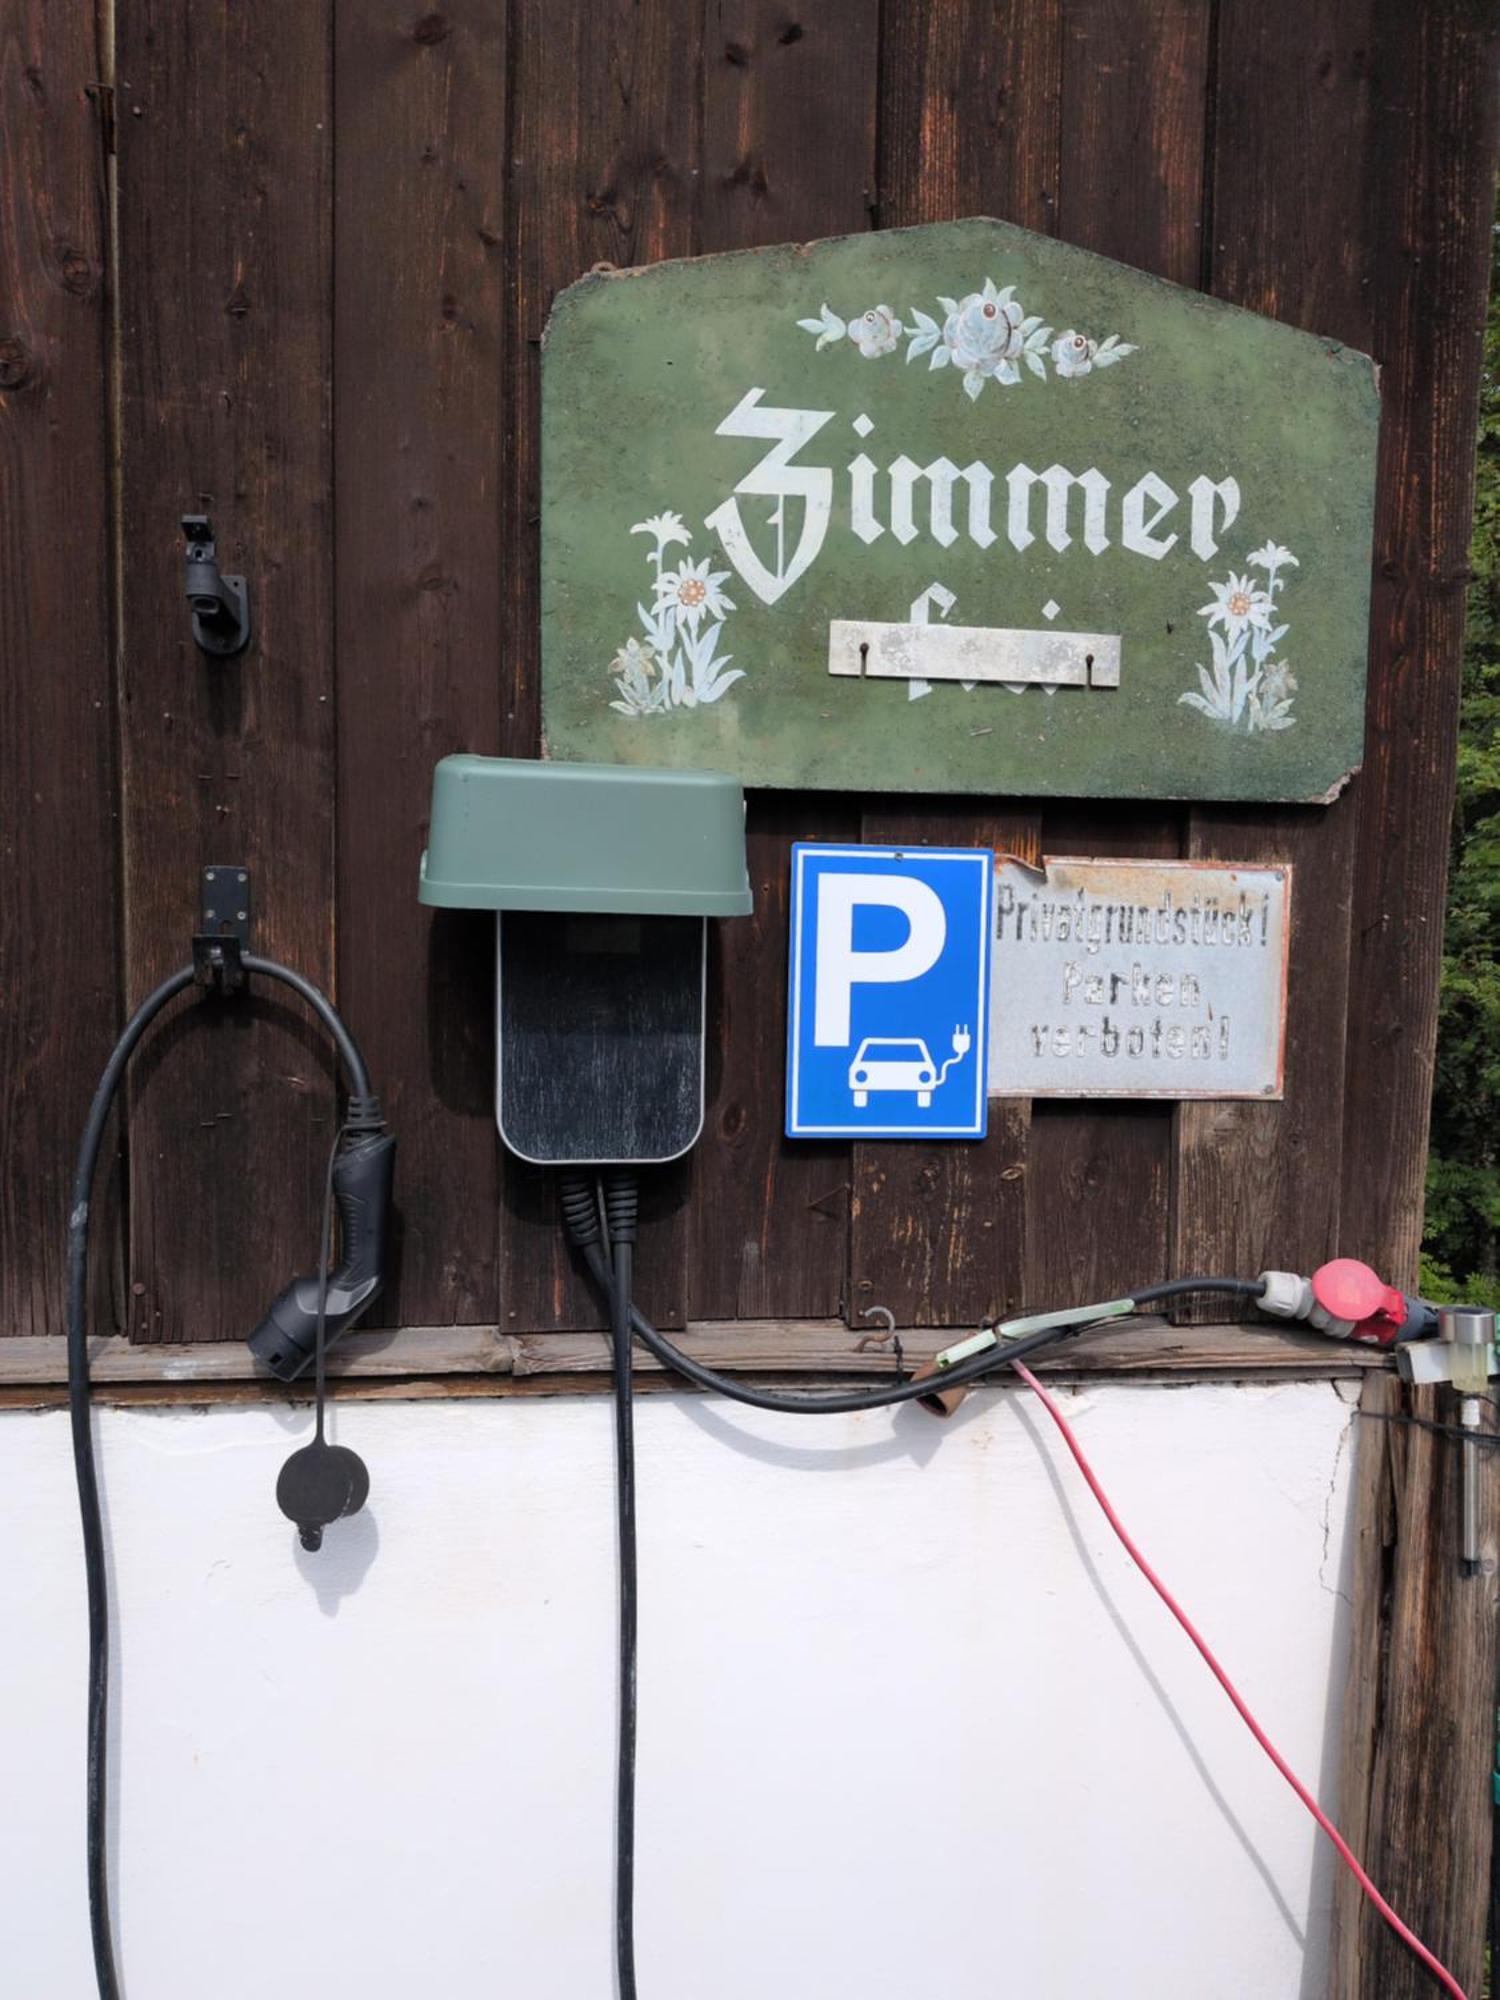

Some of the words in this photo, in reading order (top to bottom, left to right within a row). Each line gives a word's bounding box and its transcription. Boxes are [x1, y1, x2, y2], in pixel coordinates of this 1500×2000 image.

[704, 387, 1241, 604] Zimmer
[995, 883, 1270, 955] Privatgrundstück!
[813, 872, 947, 1047] P
[1061, 960, 1201, 1007] Parken
[1031, 1015, 1230, 1060] verboten!
